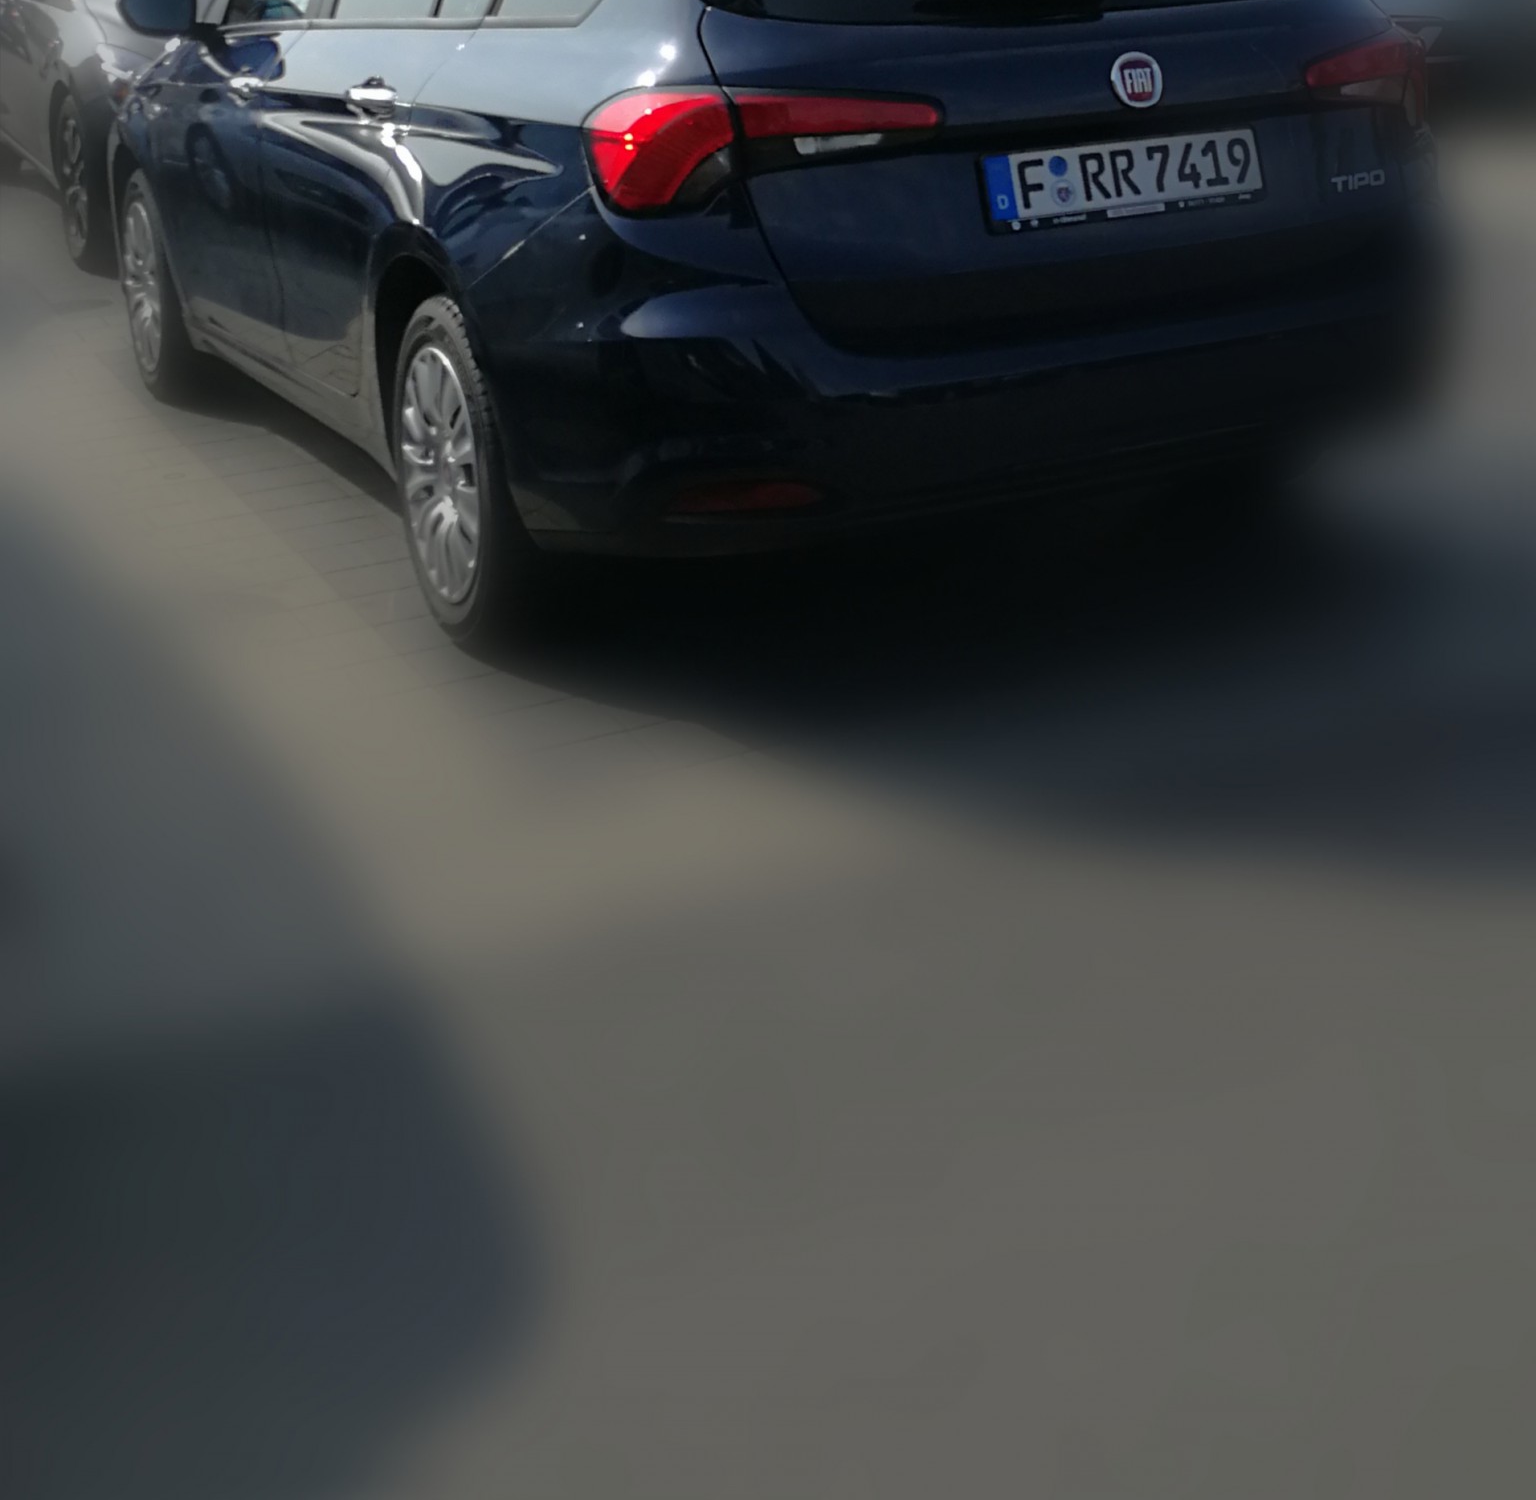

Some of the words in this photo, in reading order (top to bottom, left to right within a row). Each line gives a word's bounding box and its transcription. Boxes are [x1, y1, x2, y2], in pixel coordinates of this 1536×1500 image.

[1123, 67, 1153, 94] FIAT
[997, 195, 1010, 210] D
[1017, 158, 1044, 209] F
[1078, 149, 1142, 201] RR
[1146, 138, 1251, 192] 7419
[1330, 168, 1386, 193] TIPO
